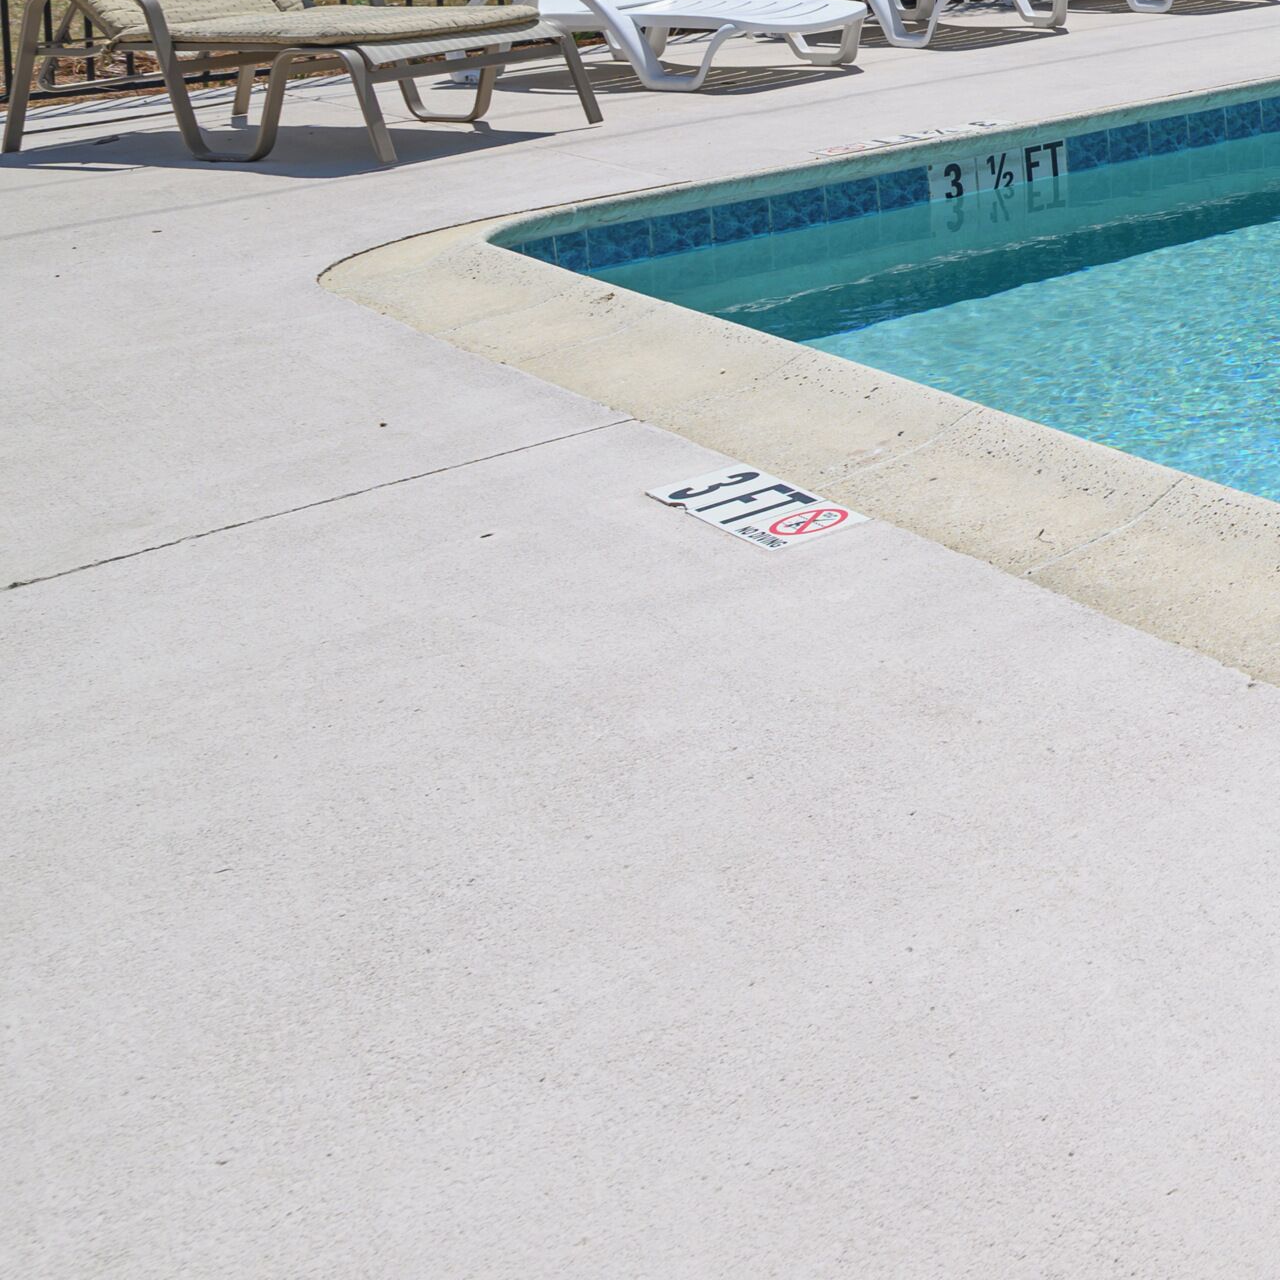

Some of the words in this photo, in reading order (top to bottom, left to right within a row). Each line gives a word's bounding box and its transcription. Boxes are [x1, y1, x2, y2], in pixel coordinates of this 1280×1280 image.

[943, 162, 965, 199] 3
[1024, 139, 1064, 183] FT
[667, 471, 761, 500] 3
[695, 483, 818, 525] FT
[734, 525, 759, 535] NO
[747, 531, 788, 548] DIVING
